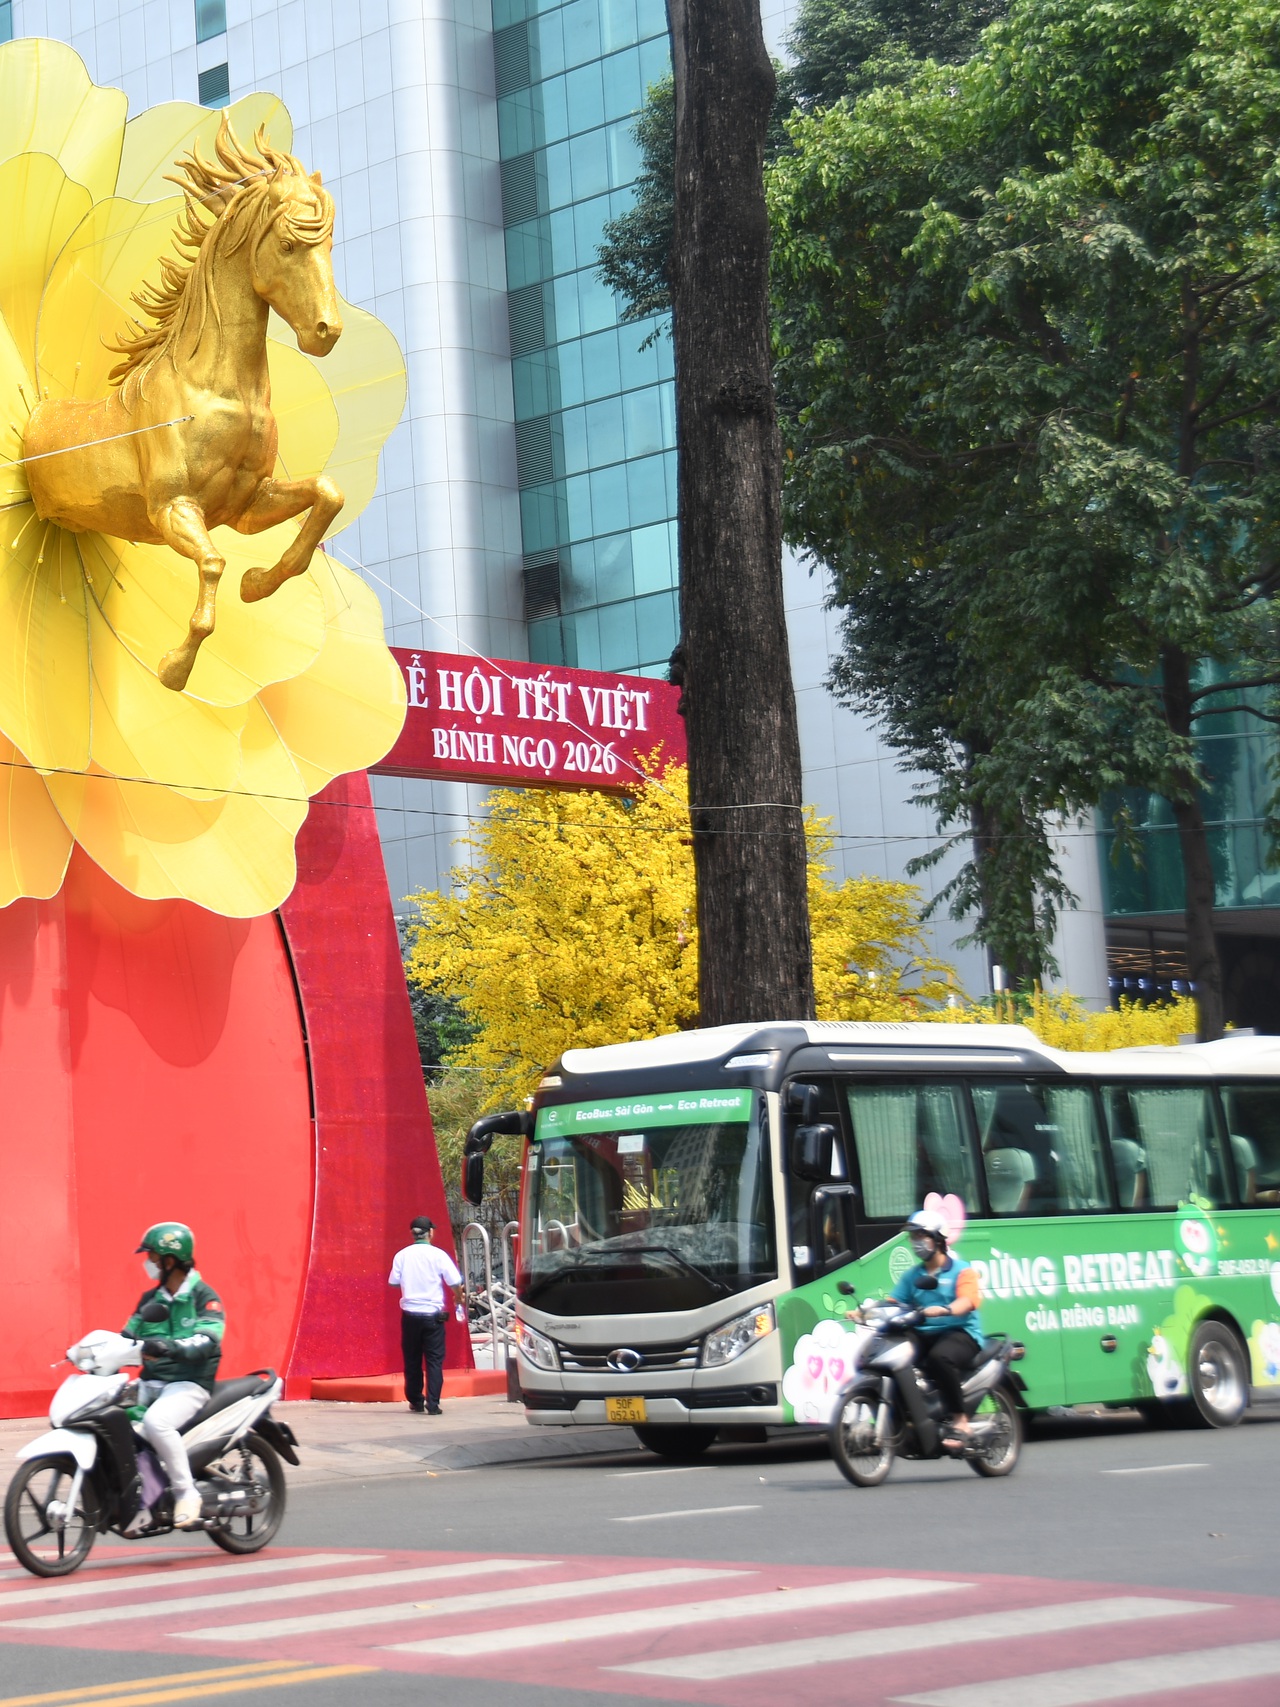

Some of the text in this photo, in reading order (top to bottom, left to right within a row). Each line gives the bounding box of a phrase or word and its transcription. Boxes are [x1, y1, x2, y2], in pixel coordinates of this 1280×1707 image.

[436, 666, 504, 725] HỘI
[511, 670, 572, 724] TẾT
[577, 683, 650, 738] VIỆT
[431, 723, 618, 776] BÍNH NGỌ 2026
[575, 1096, 741, 1121] EcoBus: Sài Gòn Eco Retreat
[1063, 1249, 1174, 1293] RETREAT
[1025, 1303, 1138, 1331] CỦA RIÊNG BẠN
